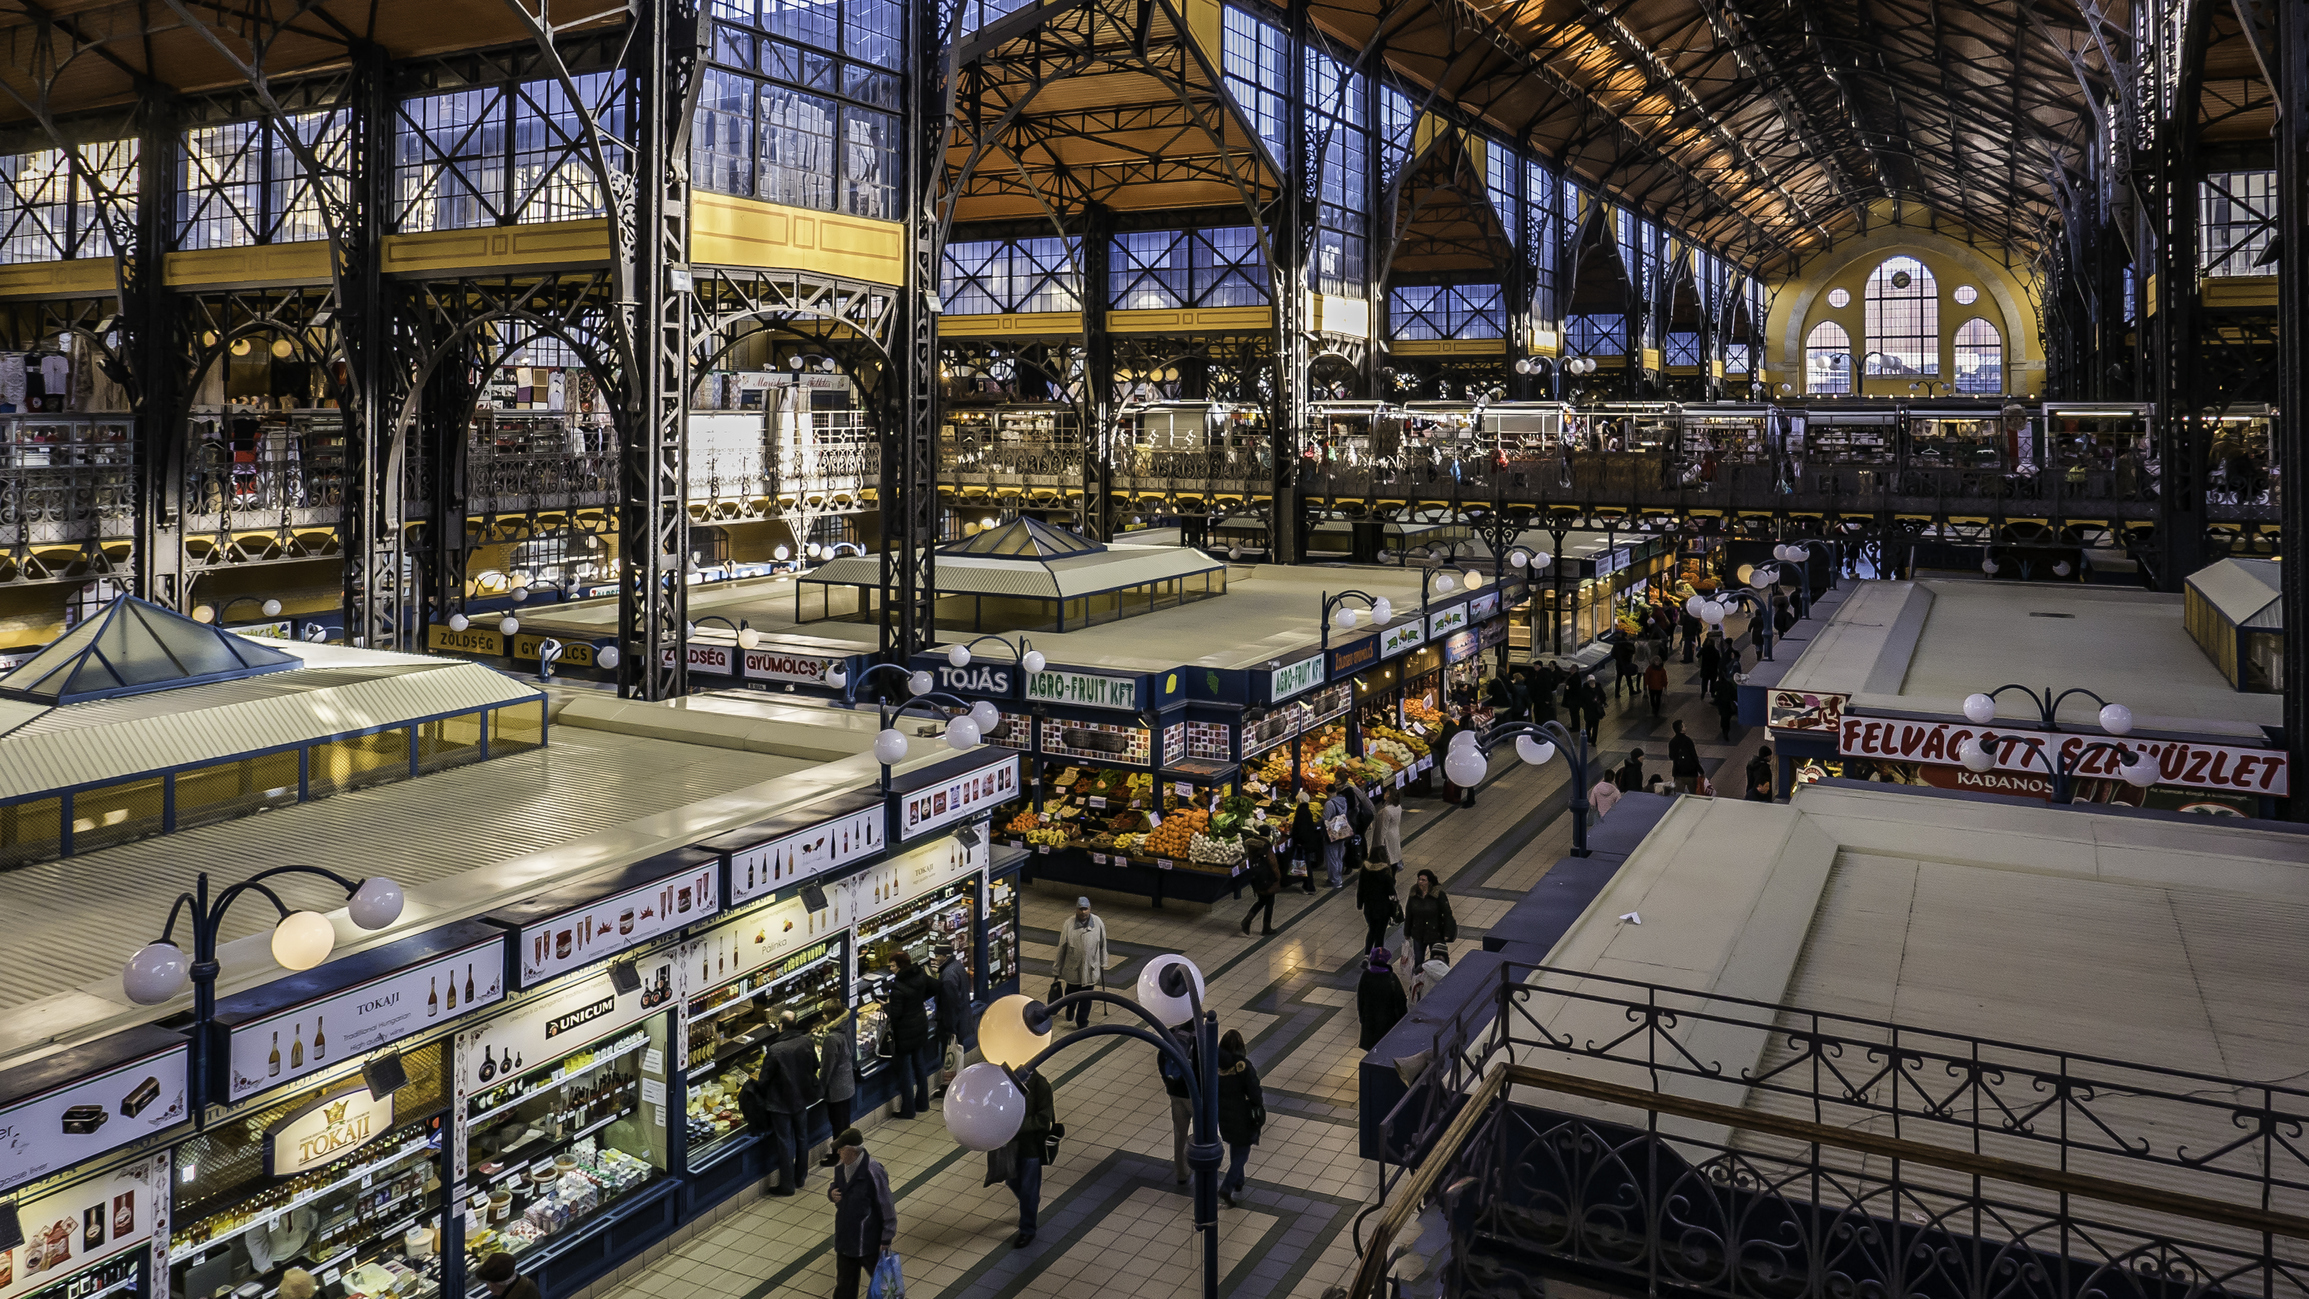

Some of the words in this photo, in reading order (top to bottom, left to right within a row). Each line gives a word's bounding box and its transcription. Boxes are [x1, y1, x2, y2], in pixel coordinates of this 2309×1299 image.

[440, 633, 493, 650] ZÖLDSÉG
[521, 641, 588, 662] GYLCS
[665, 647, 726, 667] ZDSÉG
[746, 654, 818, 676] GYÜMÖLCS
[939, 665, 1009, 693] TOJÁS
[1029, 672, 1107, 704] AGRO-FRUIT
[1110, 681, 1135, 708] KFT.
[1275, 661, 1311, 697] AGRO-FRUIT
[1842, 719, 2046, 768] FELVÁGTT
[2060, 737, 2287, 790] SZAÜZLET
[356, 991, 400, 1016] TOKAJI
[560, 999, 613, 1030] UNICUM
[378, 1012, 412, 1029] Hungarian
[299, 1115, 371, 1162] TOKAJI
